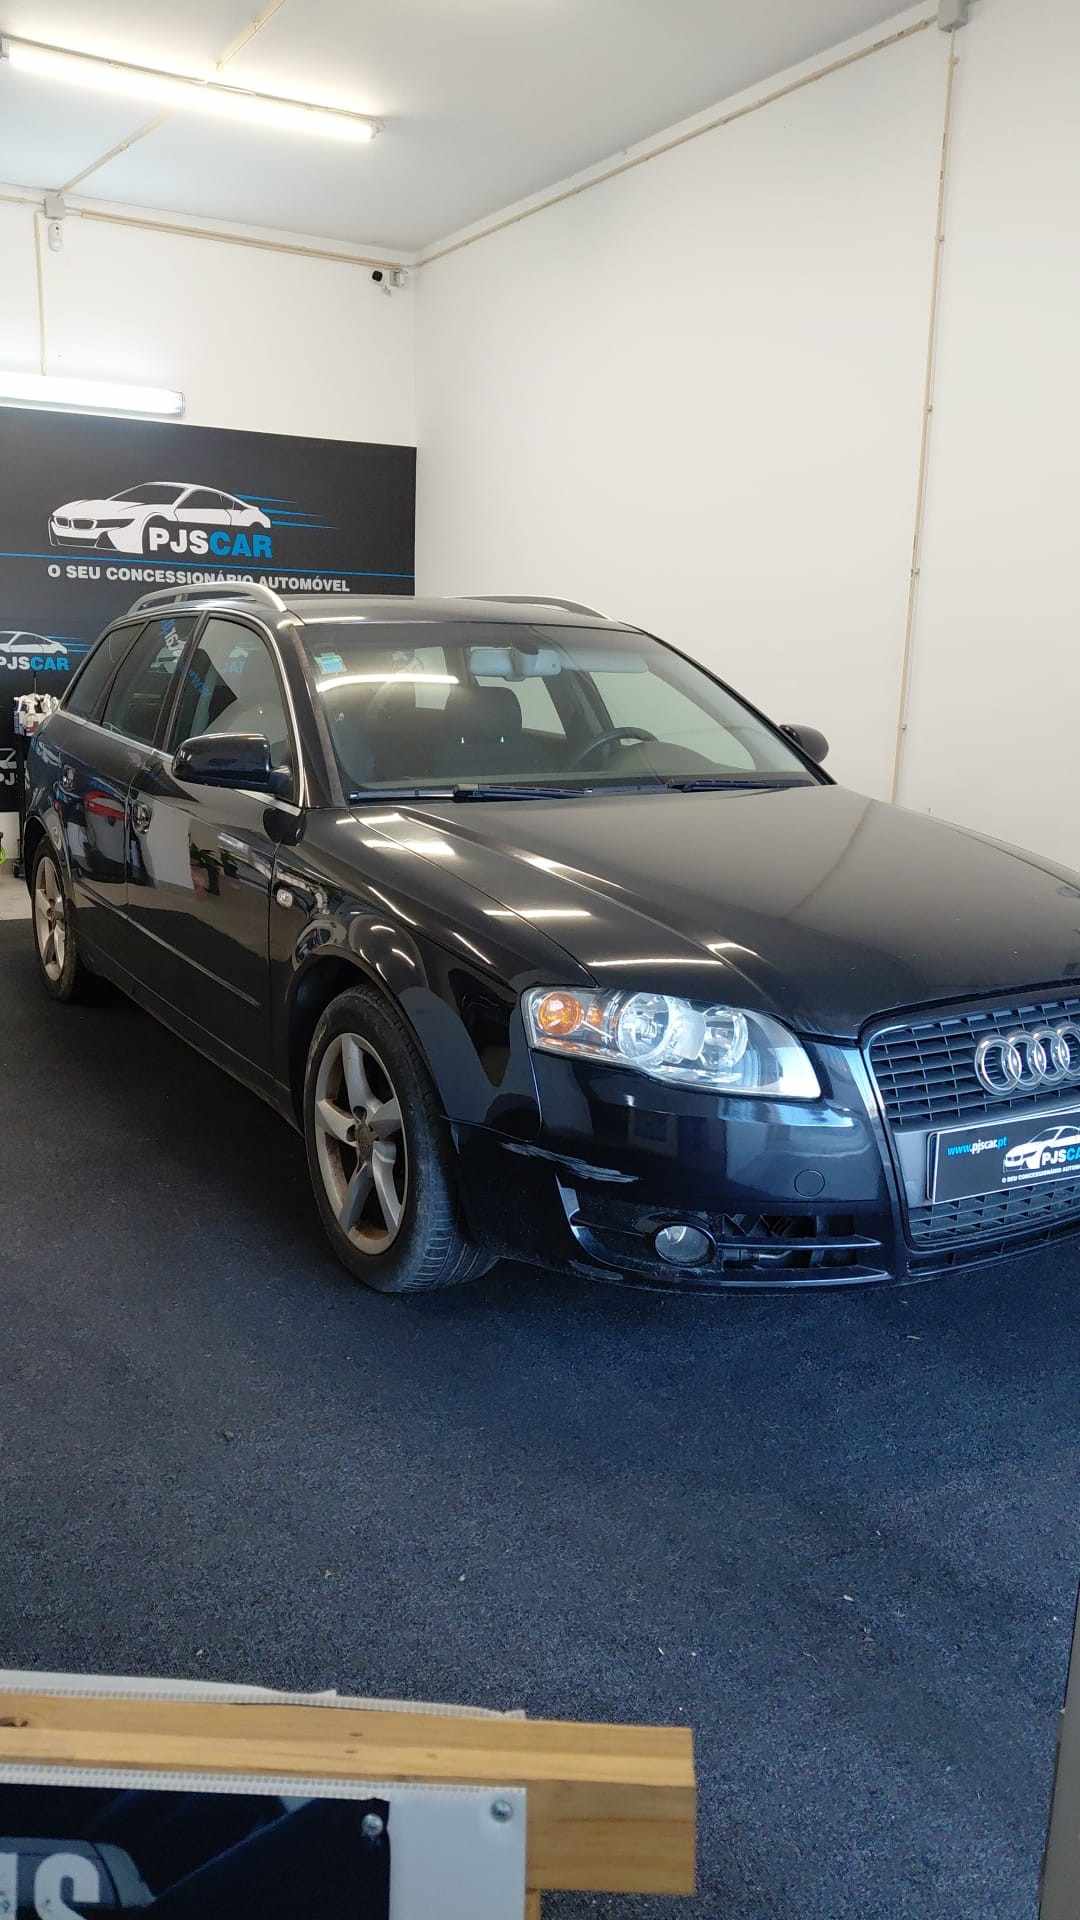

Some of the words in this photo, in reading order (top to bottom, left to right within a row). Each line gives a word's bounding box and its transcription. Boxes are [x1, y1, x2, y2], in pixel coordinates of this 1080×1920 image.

[149, 527, 272, 559] PJSCAR
[48, 564, 61, 578] O
[66, 565, 100, 579] SEU
[106, 567, 253, 584] CONCESSIONÁRIO
[258, 575, 350, 592] AUTOMÓVEL
[947, 1136, 1007, 1156] www.pjscar.pt
